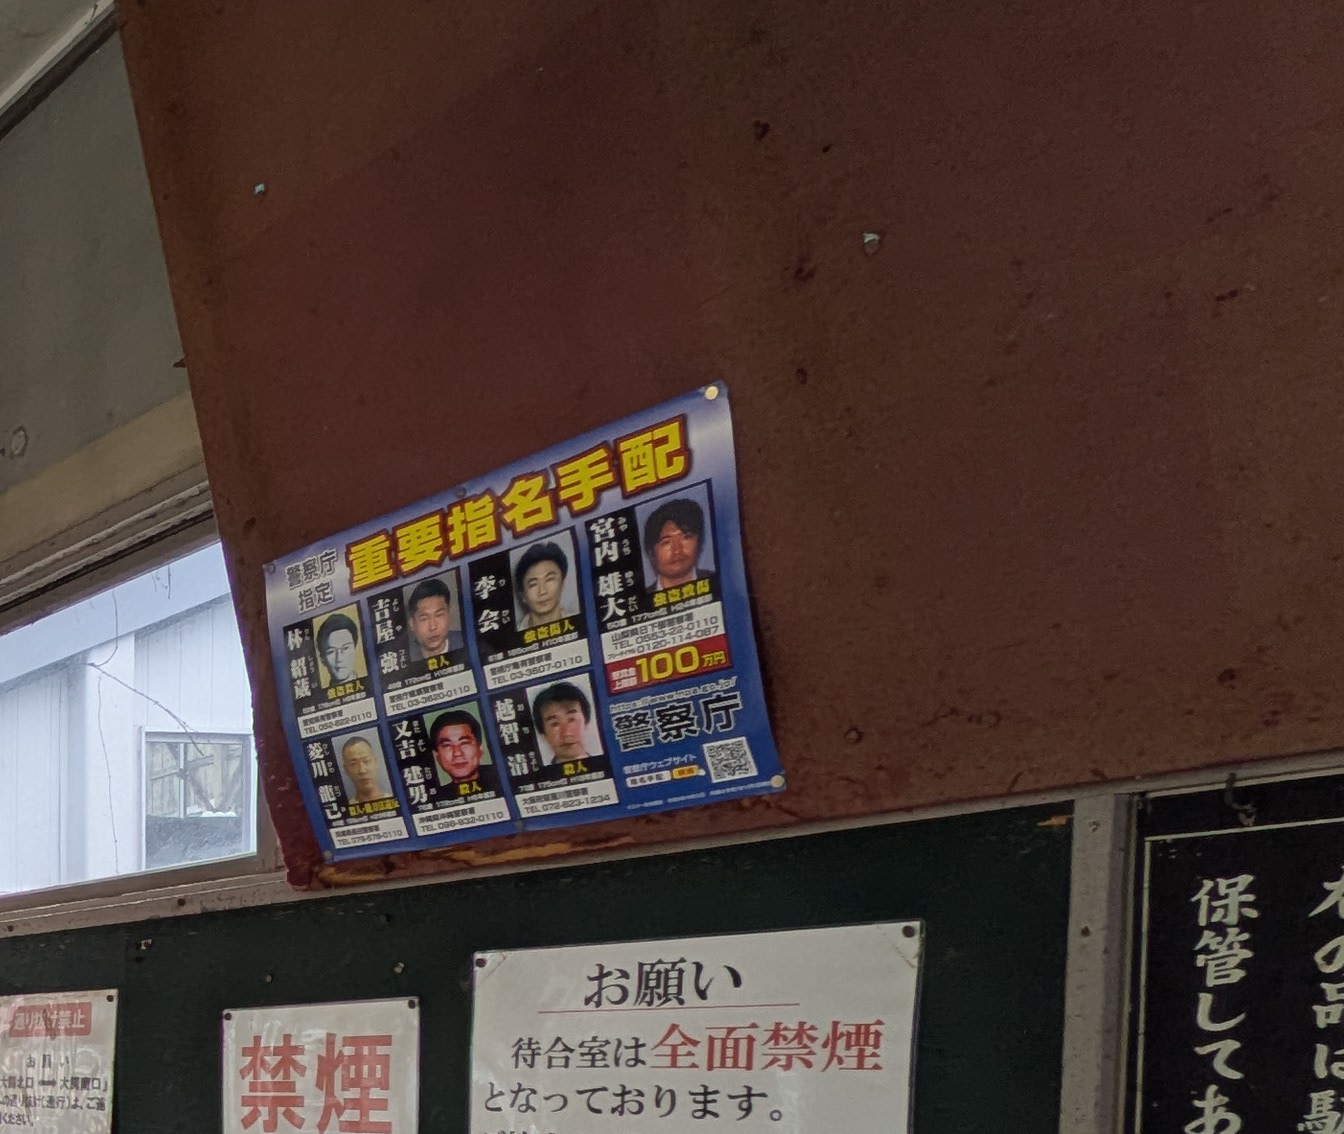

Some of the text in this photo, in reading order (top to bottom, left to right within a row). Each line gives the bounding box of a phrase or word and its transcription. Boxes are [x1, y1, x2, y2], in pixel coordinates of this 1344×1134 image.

[349, 415, 686, 593] 重要指名手配
[286, 549, 337, 587] 警察庁
[590, 518, 626, 622] 宮内 雄大
[298, 583, 333, 611] 指定
[475, 575, 499, 633] 李 会
[287, 629, 303, 650] 林
[373, 598, 399, 674] 吉屋 強
[636, 646, 726, 682] 100 万円
[612, 692, 742, 751] 警察庁
[394, 721, 428, 804] 又吉 建男
[584, 957, 743, 1009] お願い
[512, 1018, 885, 1072] 待合室は全面禁煙
[484, 1082, 784, 1123] となっております。
